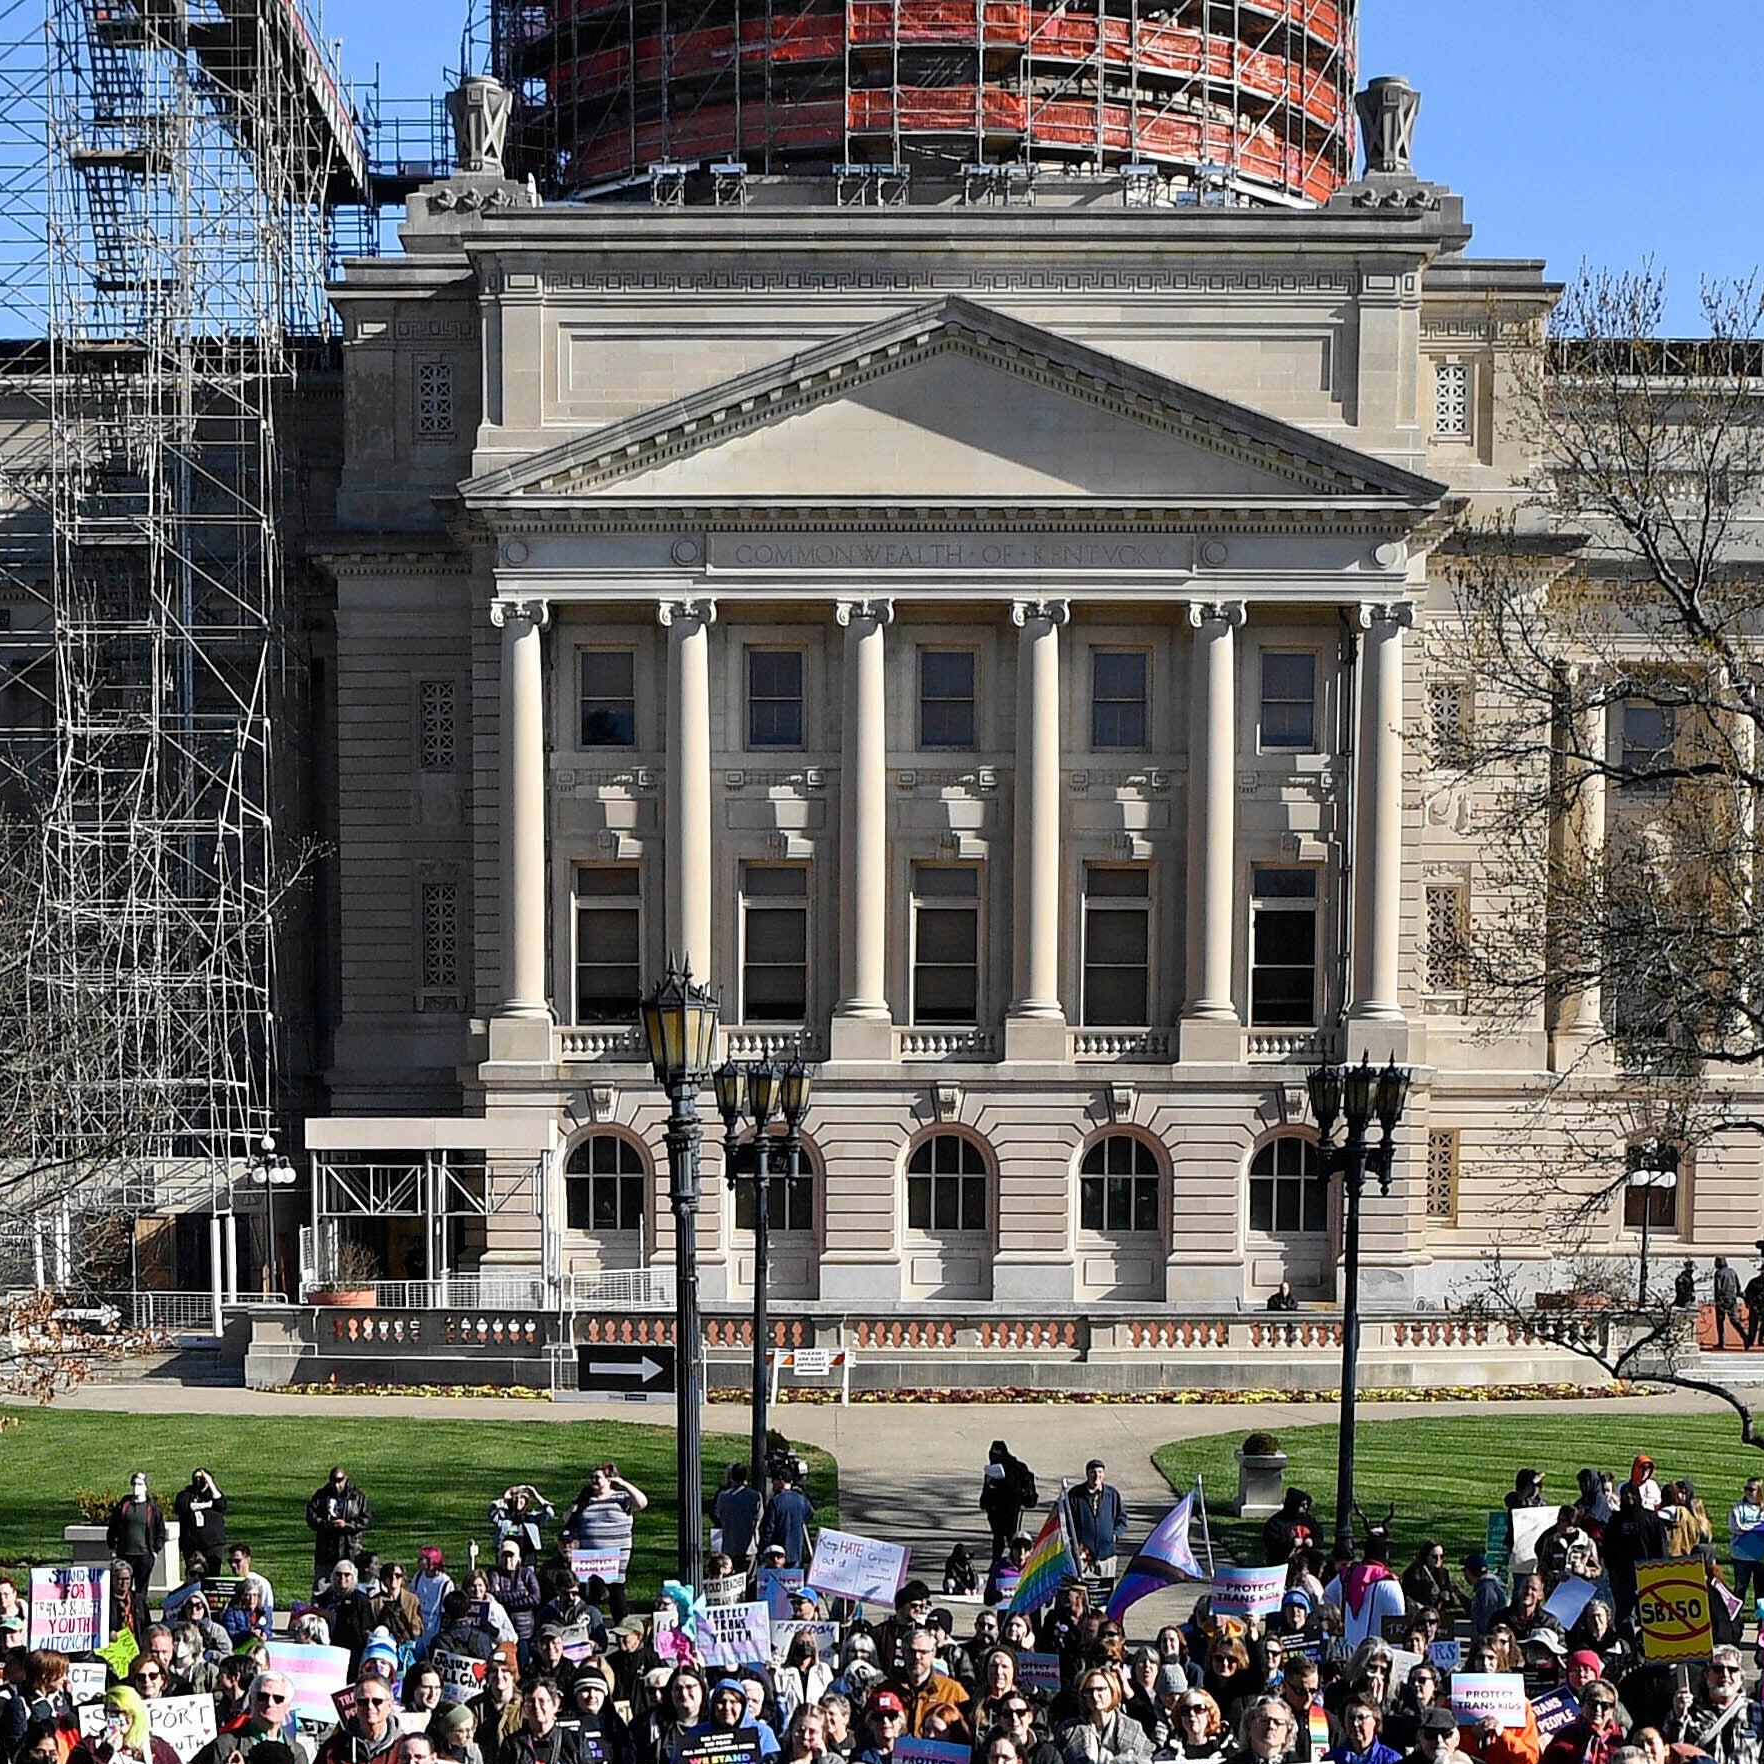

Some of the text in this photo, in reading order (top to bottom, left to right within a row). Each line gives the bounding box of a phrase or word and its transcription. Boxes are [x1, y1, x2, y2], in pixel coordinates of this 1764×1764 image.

[839, 1538, 864, 1558] HATE
[63, 1584, 86, 1600] FOR
[1226, 1582, 1276, 1593] PROTECT
[1216, 1592, 1257, 1604] TRANS
[705, 1606, 750, 1620] PROTECT
[1640, 1597, 1702, 1625] SB150
[47, 1617, 92, 1634] YOUTH
[713, 1617, 746, 1630] TRANS
[776, 1620, 836, 1637] FREEDOM
[38, 1633, 98, 1652] AUTONOMY
[711, 1629, 753, 1643] YOUTH
[433, 1652, 471, 1671] Jesus
[1457, 1700, 1495, 1711] TRANS
[1537, 1708, 1576, 1734] PEOPLE
[711, 1752, 751, 1764] STAND
